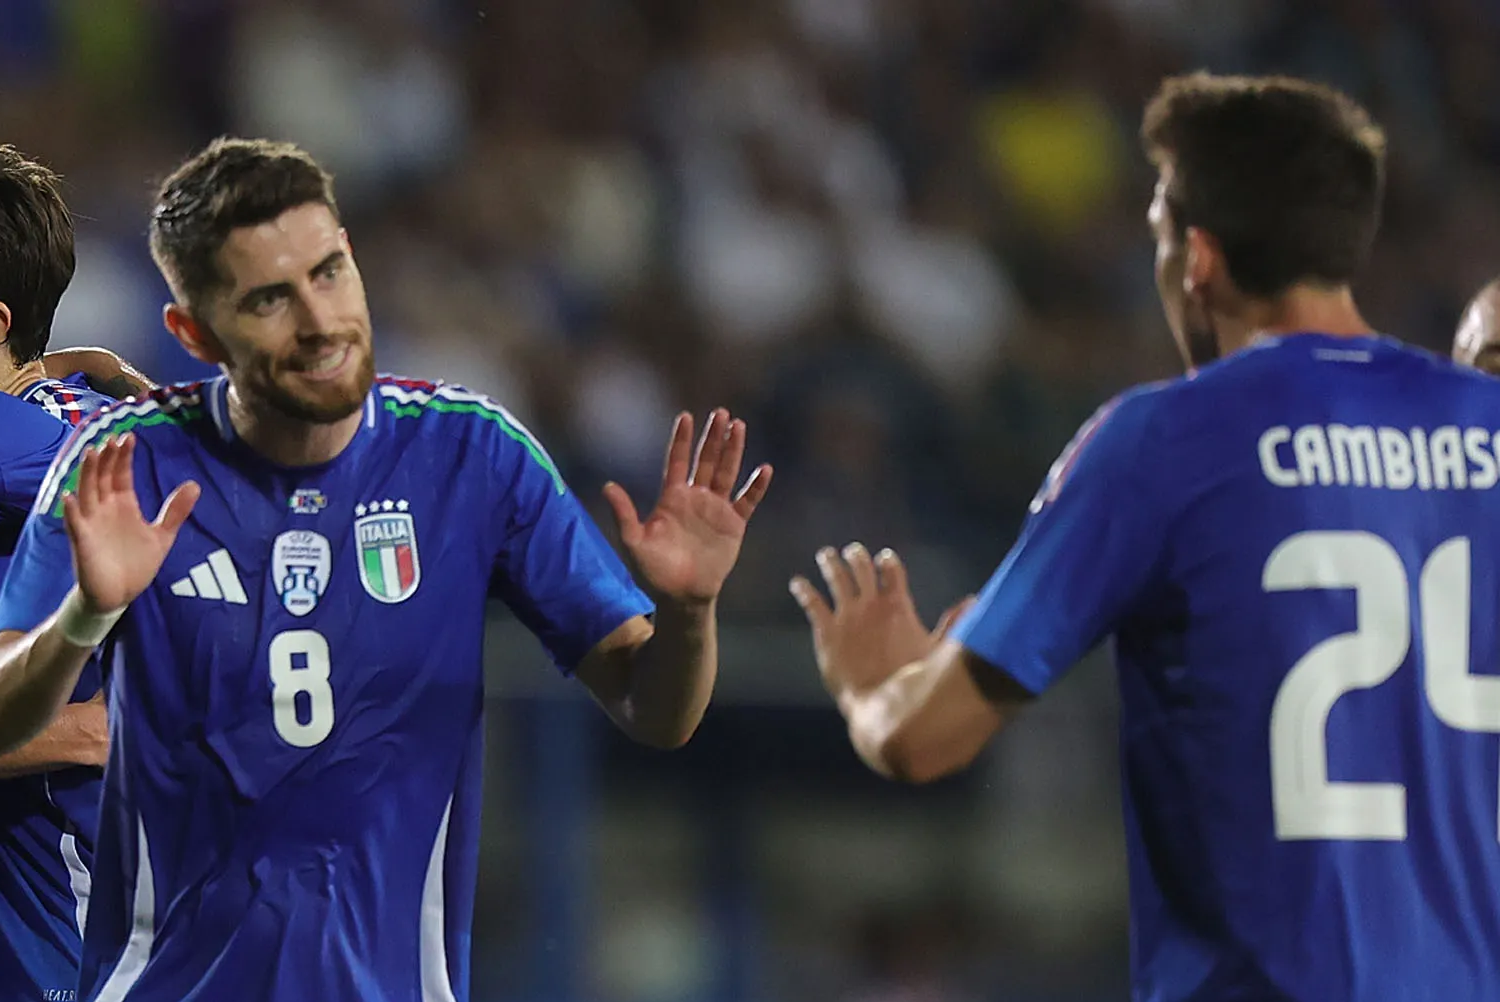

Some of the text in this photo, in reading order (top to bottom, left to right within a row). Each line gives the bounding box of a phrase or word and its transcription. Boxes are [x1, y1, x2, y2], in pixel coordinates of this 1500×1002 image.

[1258, 423, 1500, 491] CAMBIAS
[361, 520, 409, 542] ITALIA
[269, 630, 335, 748] 8
